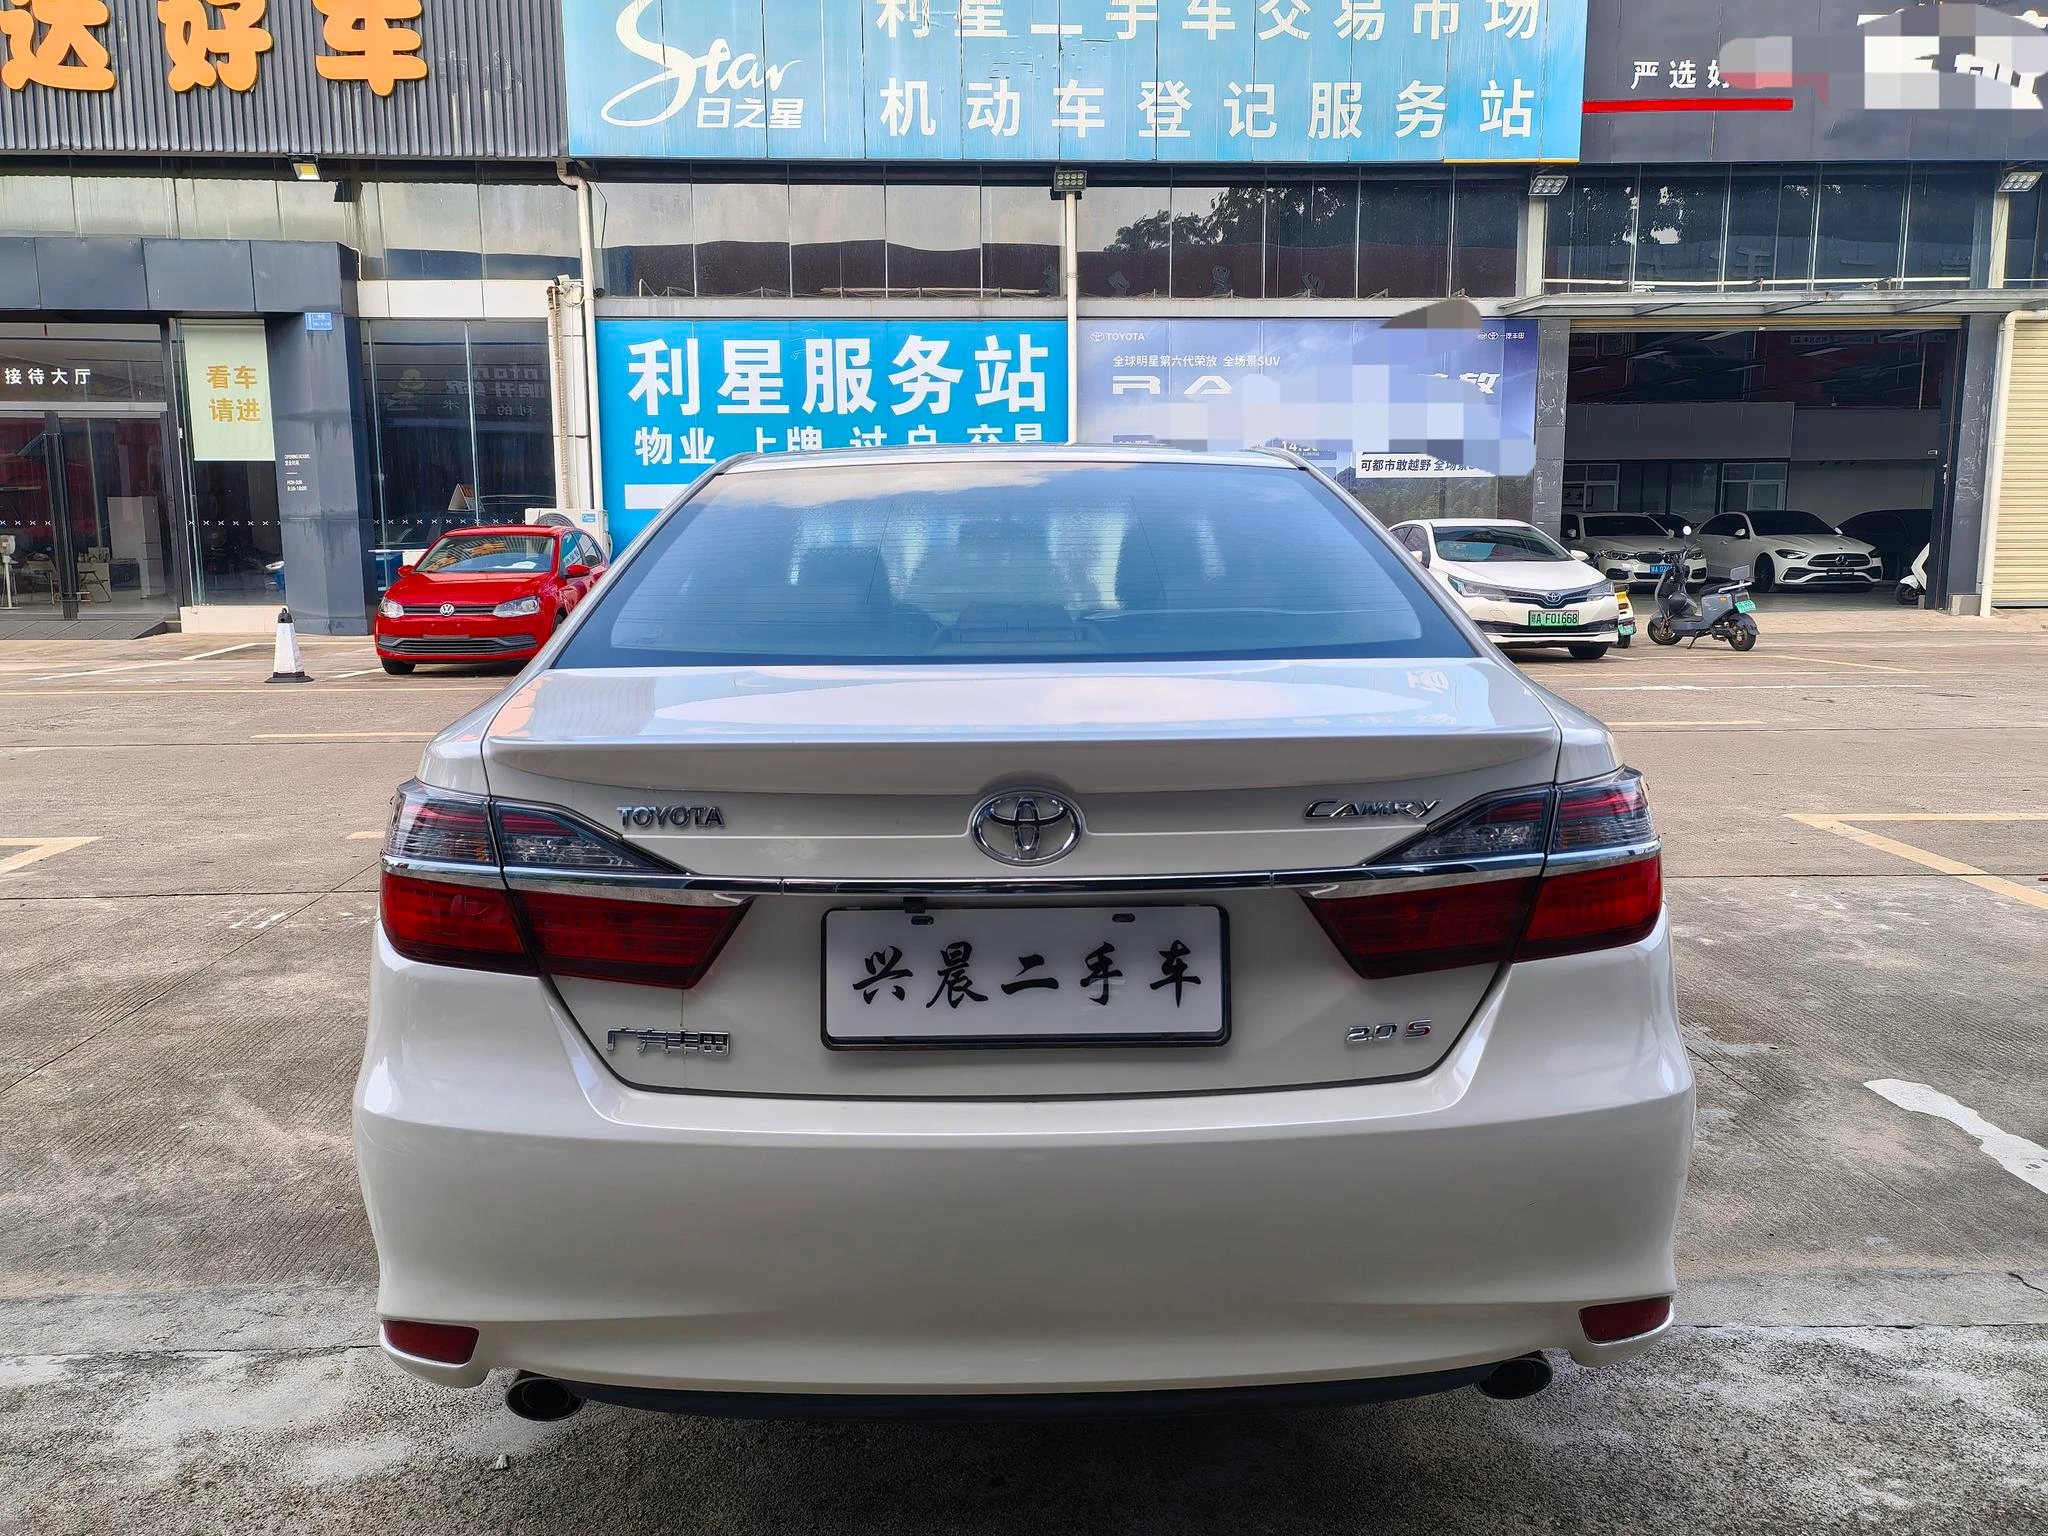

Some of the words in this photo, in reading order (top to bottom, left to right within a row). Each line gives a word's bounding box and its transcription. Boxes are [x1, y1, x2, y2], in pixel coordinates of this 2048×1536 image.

[600, 0, 802, 127] Star
[696, 97, 804, 129] 日之星
[880, 78, 1536, 138] 机动车登记服务站
[1106, 333, 1145, 341] TOYOTA
[1113, 355, 1217, 367] 全球明星第六代荣放
[1223, 355, 1281, 367] 全场景SUV
[5, 367, 91, 385] 接待大厅
[206, 364, 258, 389] 看车
[627, 334, 1049, 416] 利星服务站
[208, 398, 261, 423] 请进
[635, 426, 717, 466] 物业
[1361, 459, 1431, 471] 可都市敢越野
[617, 806, 726, 828] TOYOTA
[1304, 799, 1441, 819] CAMRY
[853, 940, 1201, 1008] 兴晨二手车
[1346, 1023, 1398, 1041] 2.0
[1403, 1019, 1432, 1039] S
